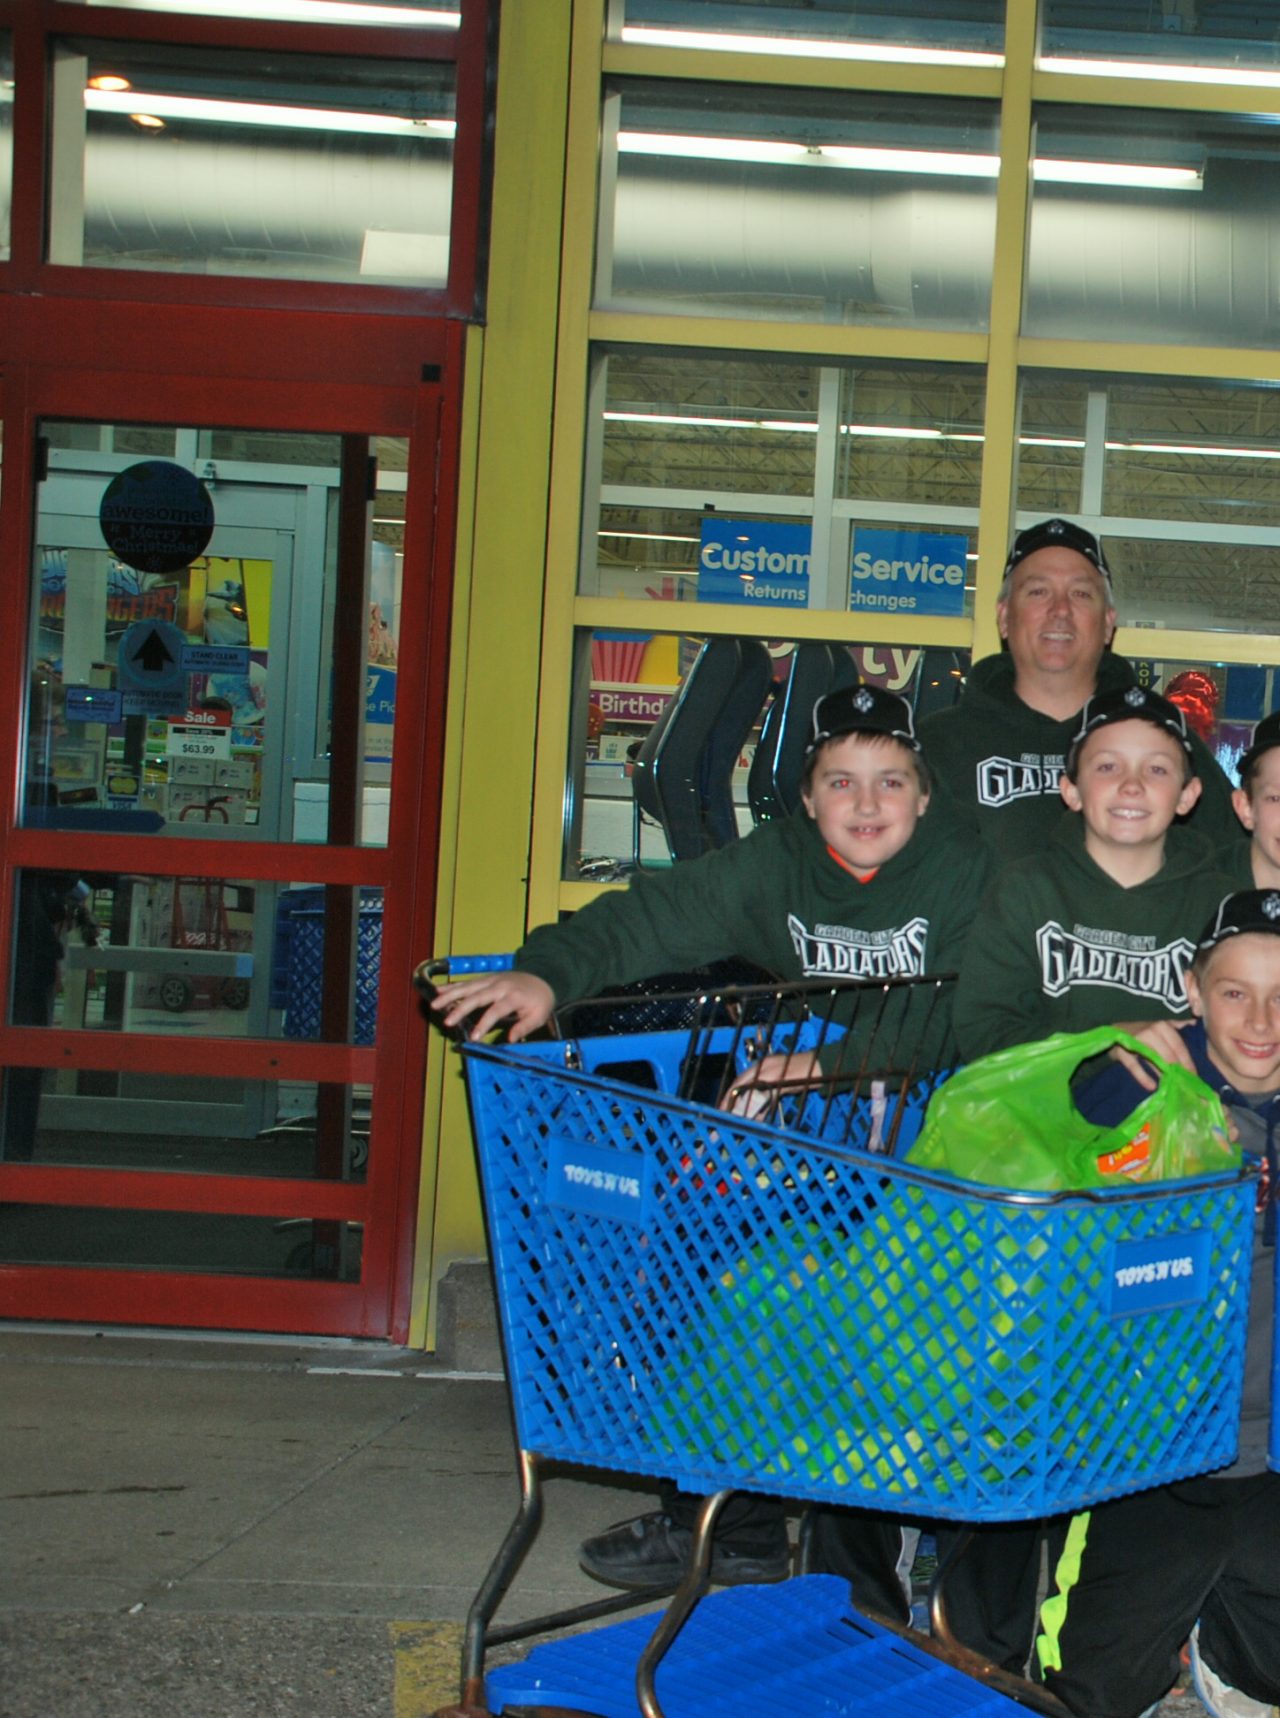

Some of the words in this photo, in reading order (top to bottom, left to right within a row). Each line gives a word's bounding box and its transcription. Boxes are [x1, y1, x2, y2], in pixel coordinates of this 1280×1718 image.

[102, 504, 209, 524] awesome!
[130, 525, 182, 539] Merry
[701, 542, 811, 576] Custom
[853, 552, 964, 586] Service
[744, 583, 806, 601] Returns
[850, 589, 917, 611] changes
[599, 693, 665, 716] Birthd
[184, 710, 216, 725] Sale
[182, 743, 215, 754] $63.99
[1040, 926, 1194, 1004] GADIATORS
[564, 1164, 603, 1190] TOYS
[618, 1176, 640, 1198] US
[1115, 1263, 1156, 1288] TOYS
[1171, 1256, 1193, 1278] US
